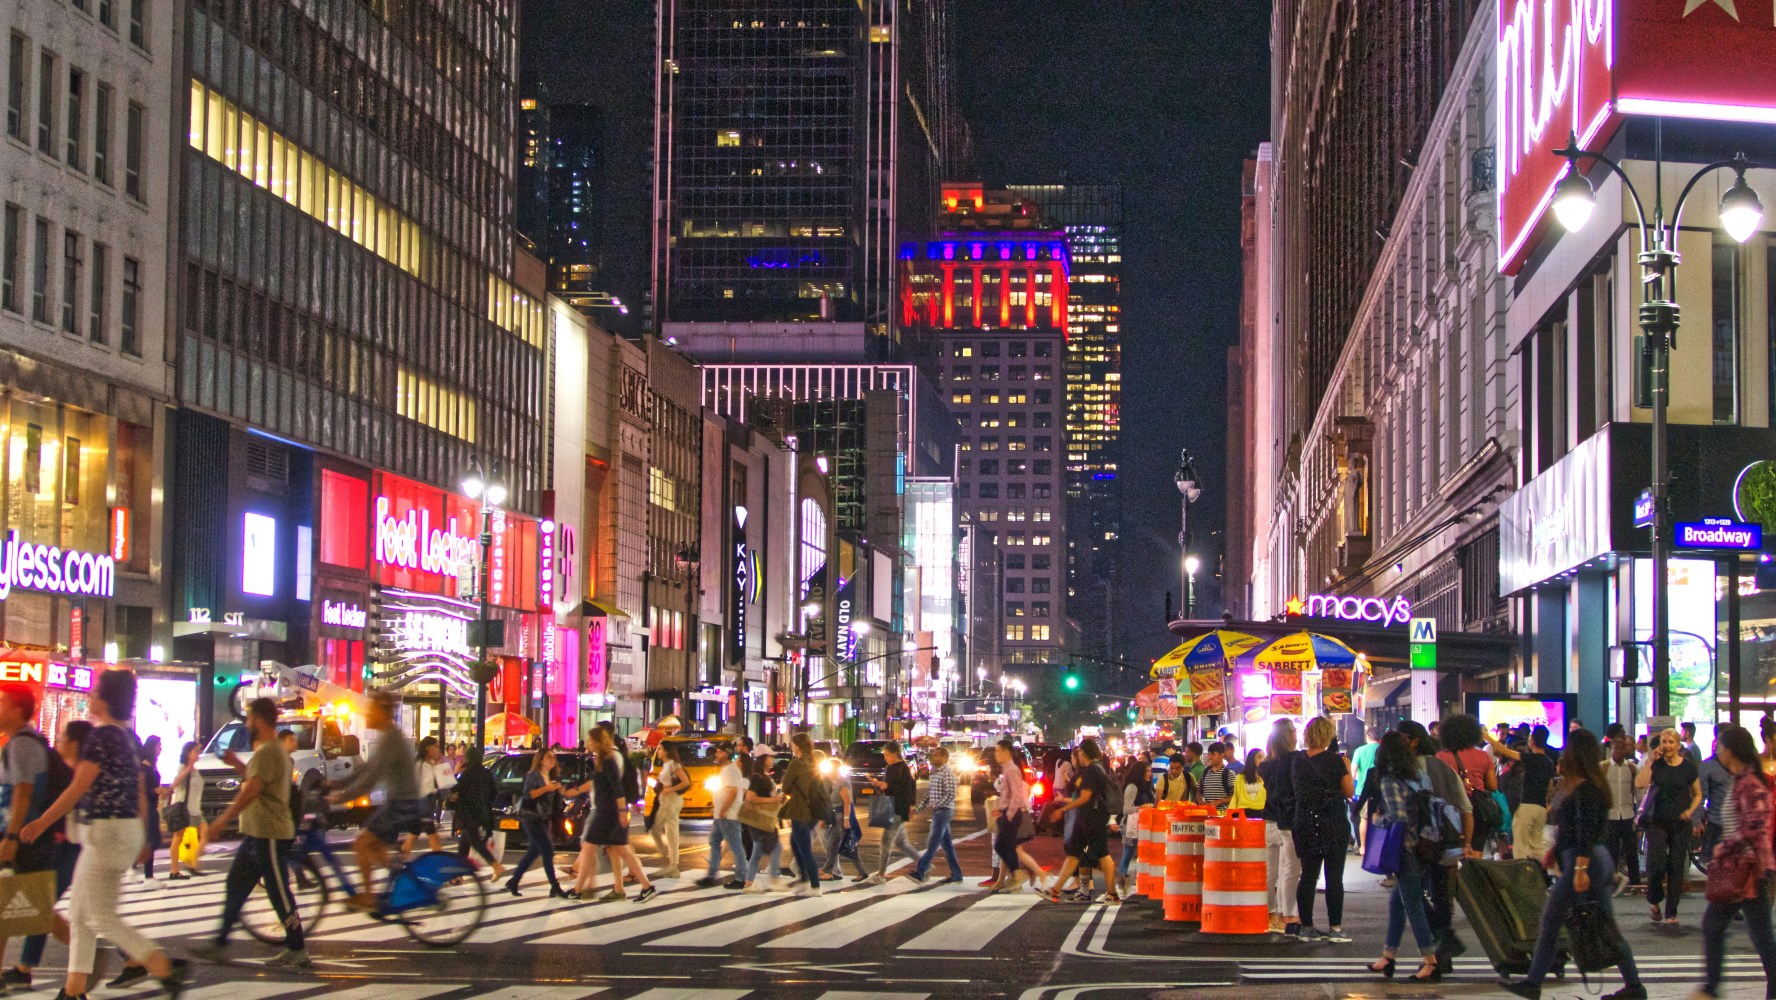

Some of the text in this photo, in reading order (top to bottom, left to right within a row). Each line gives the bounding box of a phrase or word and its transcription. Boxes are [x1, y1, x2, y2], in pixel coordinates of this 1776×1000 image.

[375, 496, 477, 577] Foot Locker
[1684, 526, 1751, 547] Broadway
[541, 534, 553, 605] target
[737, 544, 746, 591] KAY
[189, 607, 211, 623] 112
[323, 599, 366, 628] Foot Locker
[1308, 593, 1411, 628] macy's
[588, 620, 600, 644] 30
[836, 600, 850, 660] OLD NAVY
[588, 652, 600, 676] 50
[1258, 660, 1311, 670] SABRETT
[1172, 825, 1195, 833] TRAFFIC
